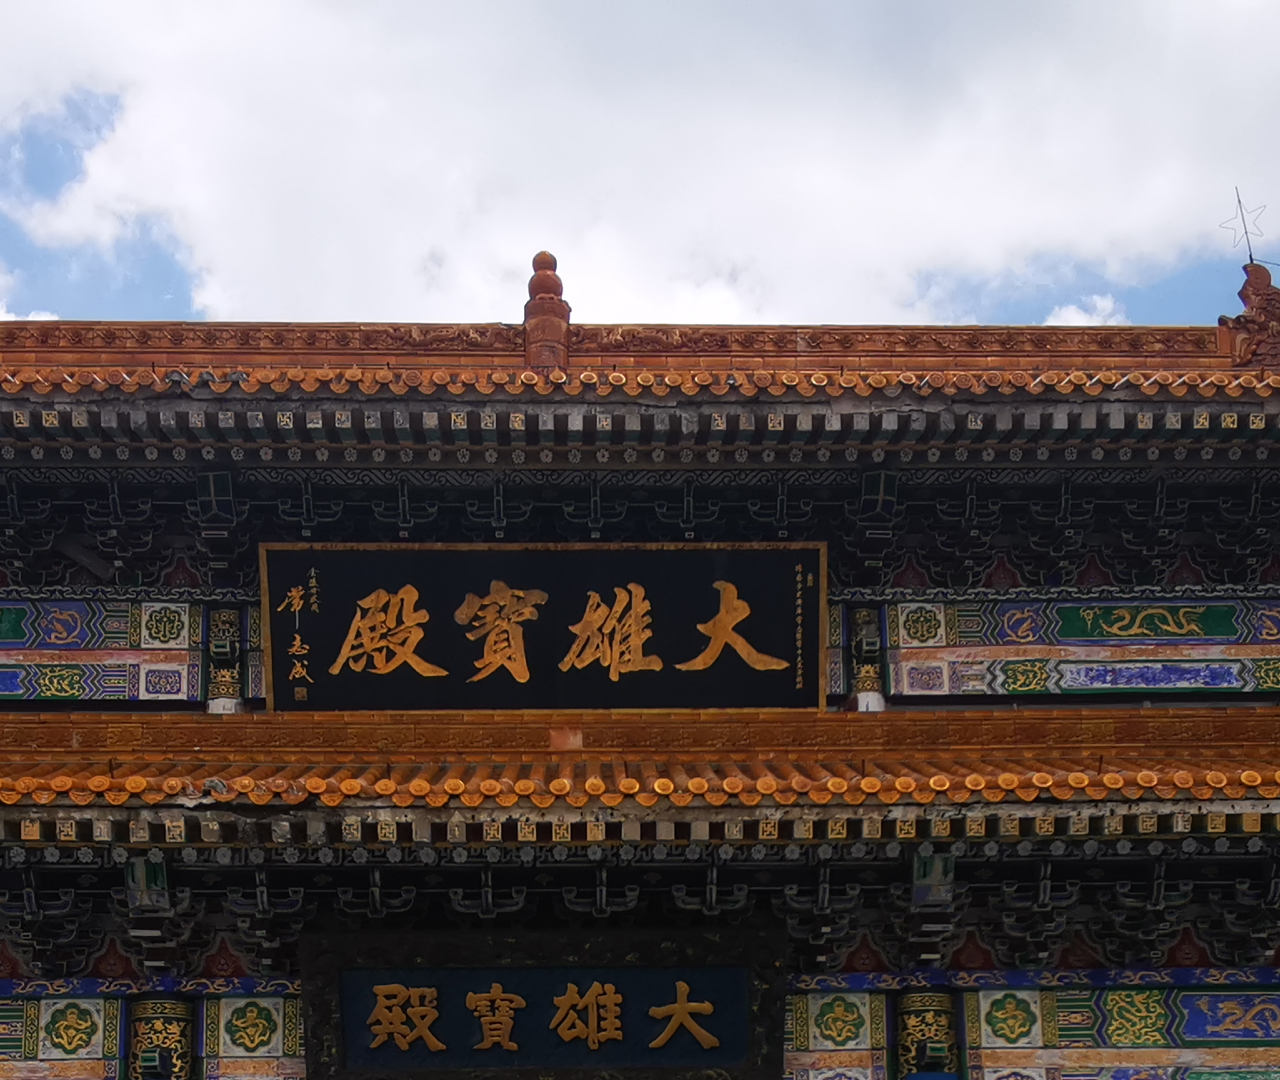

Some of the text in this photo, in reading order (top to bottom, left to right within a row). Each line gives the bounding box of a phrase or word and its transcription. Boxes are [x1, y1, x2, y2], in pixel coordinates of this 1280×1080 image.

[328, 580, 791, 684] 大雄寶殿
[365, 980, 721, 1052] 大雄寶殿
